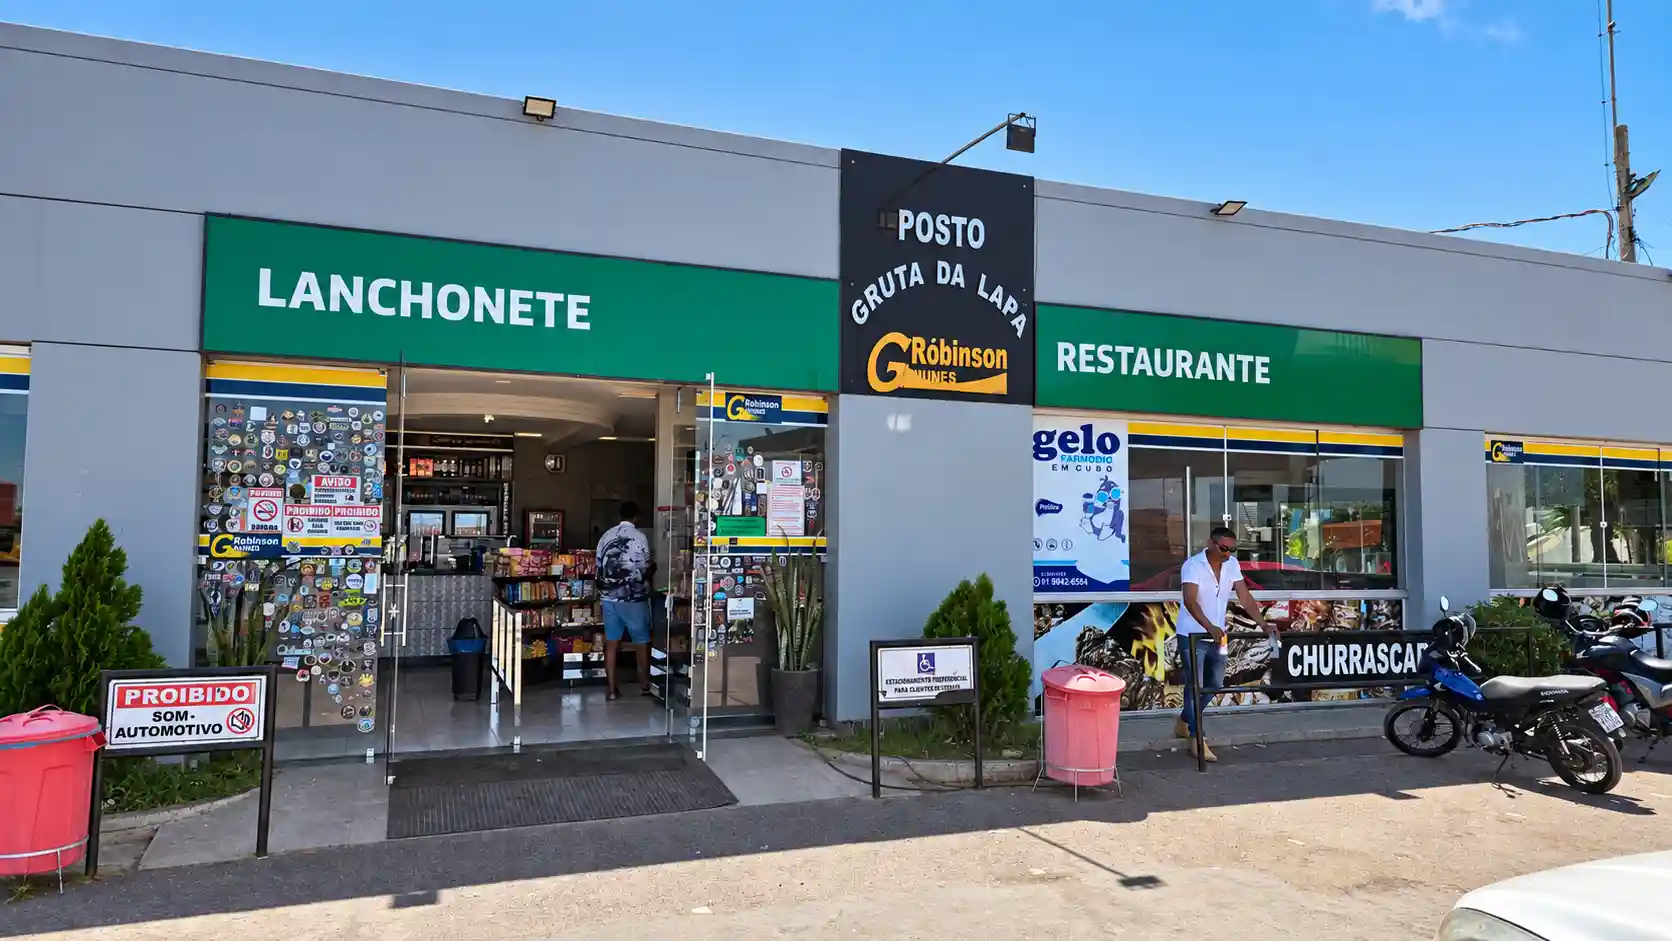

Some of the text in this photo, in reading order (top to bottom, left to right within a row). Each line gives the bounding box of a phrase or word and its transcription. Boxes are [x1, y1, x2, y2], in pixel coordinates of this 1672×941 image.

[899, 208, 986, 250] POSTO
[258, 267, 591, 331] LANCHONETE
[851, 260, 1027, 339] GRUTA DA LAPA
[1057, 341, 1271, 384] RESTAURANTE
[1032, 423, 1121, 462] gelo
[1051, 464, 1113, 473] EM CUBO
[125, 685, 251, 706] PROIBIDO
[114, 723, 223, 739] AUTOMOTIVO
